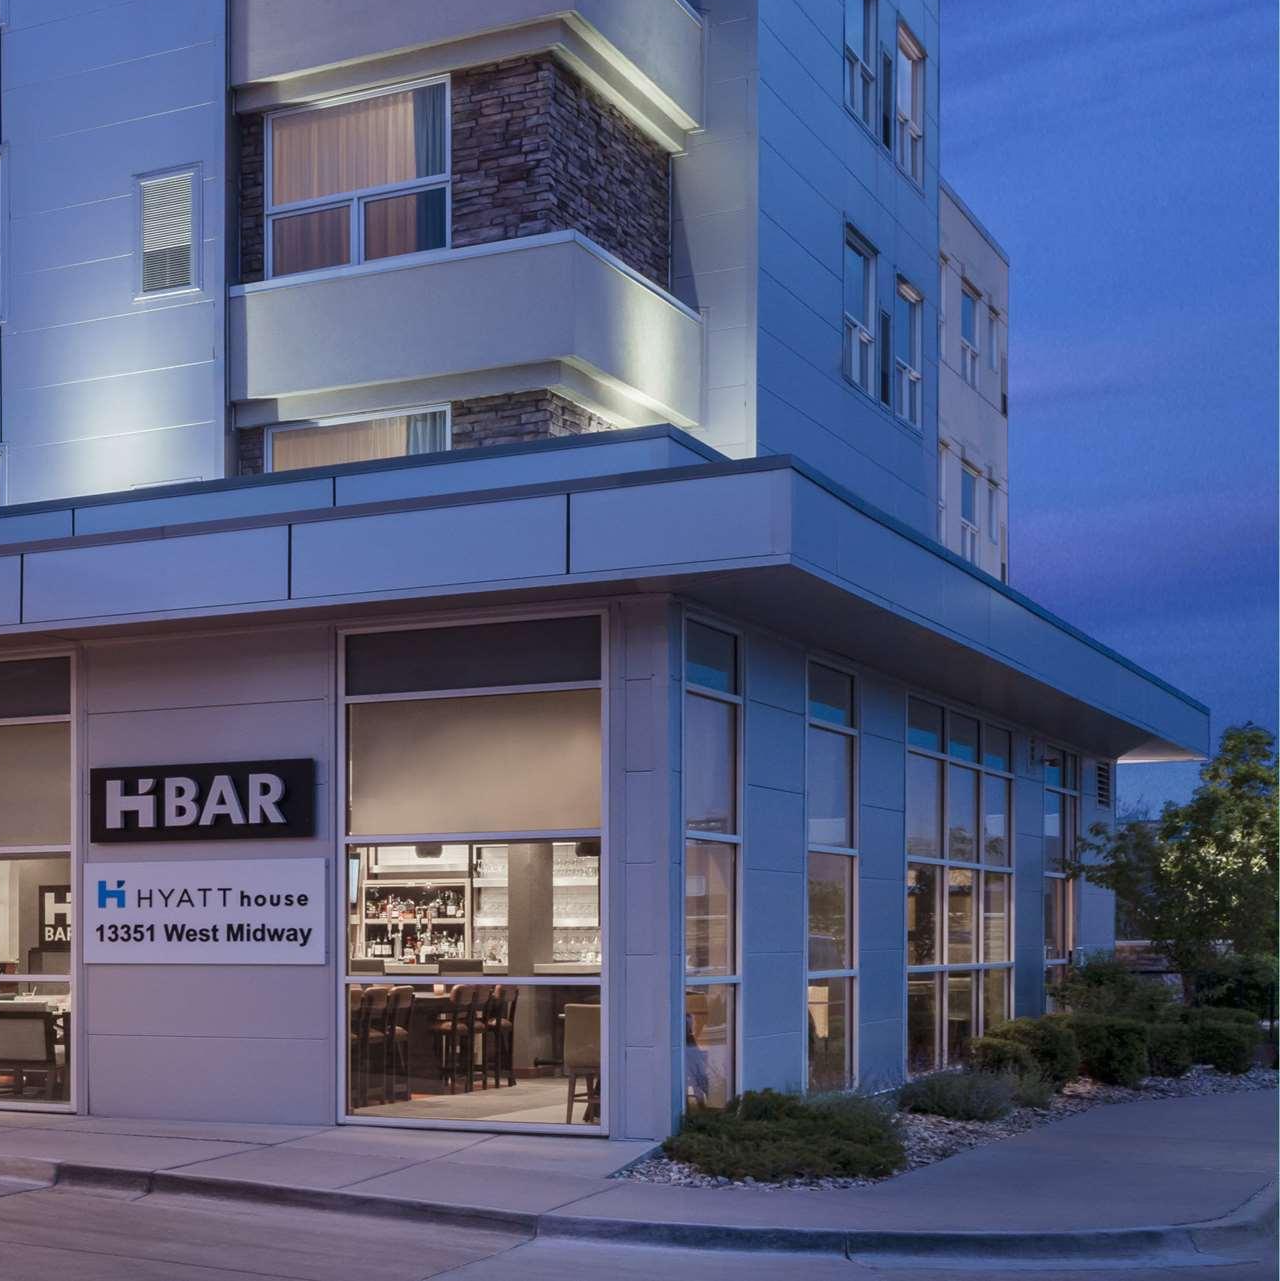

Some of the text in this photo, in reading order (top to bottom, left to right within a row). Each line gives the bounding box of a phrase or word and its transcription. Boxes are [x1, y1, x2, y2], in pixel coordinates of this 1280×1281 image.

[137, 888, 233, 908] HYATT
[240, 890, 309, 907] house
[95, 923, 312, 947] 13351 West Midway
